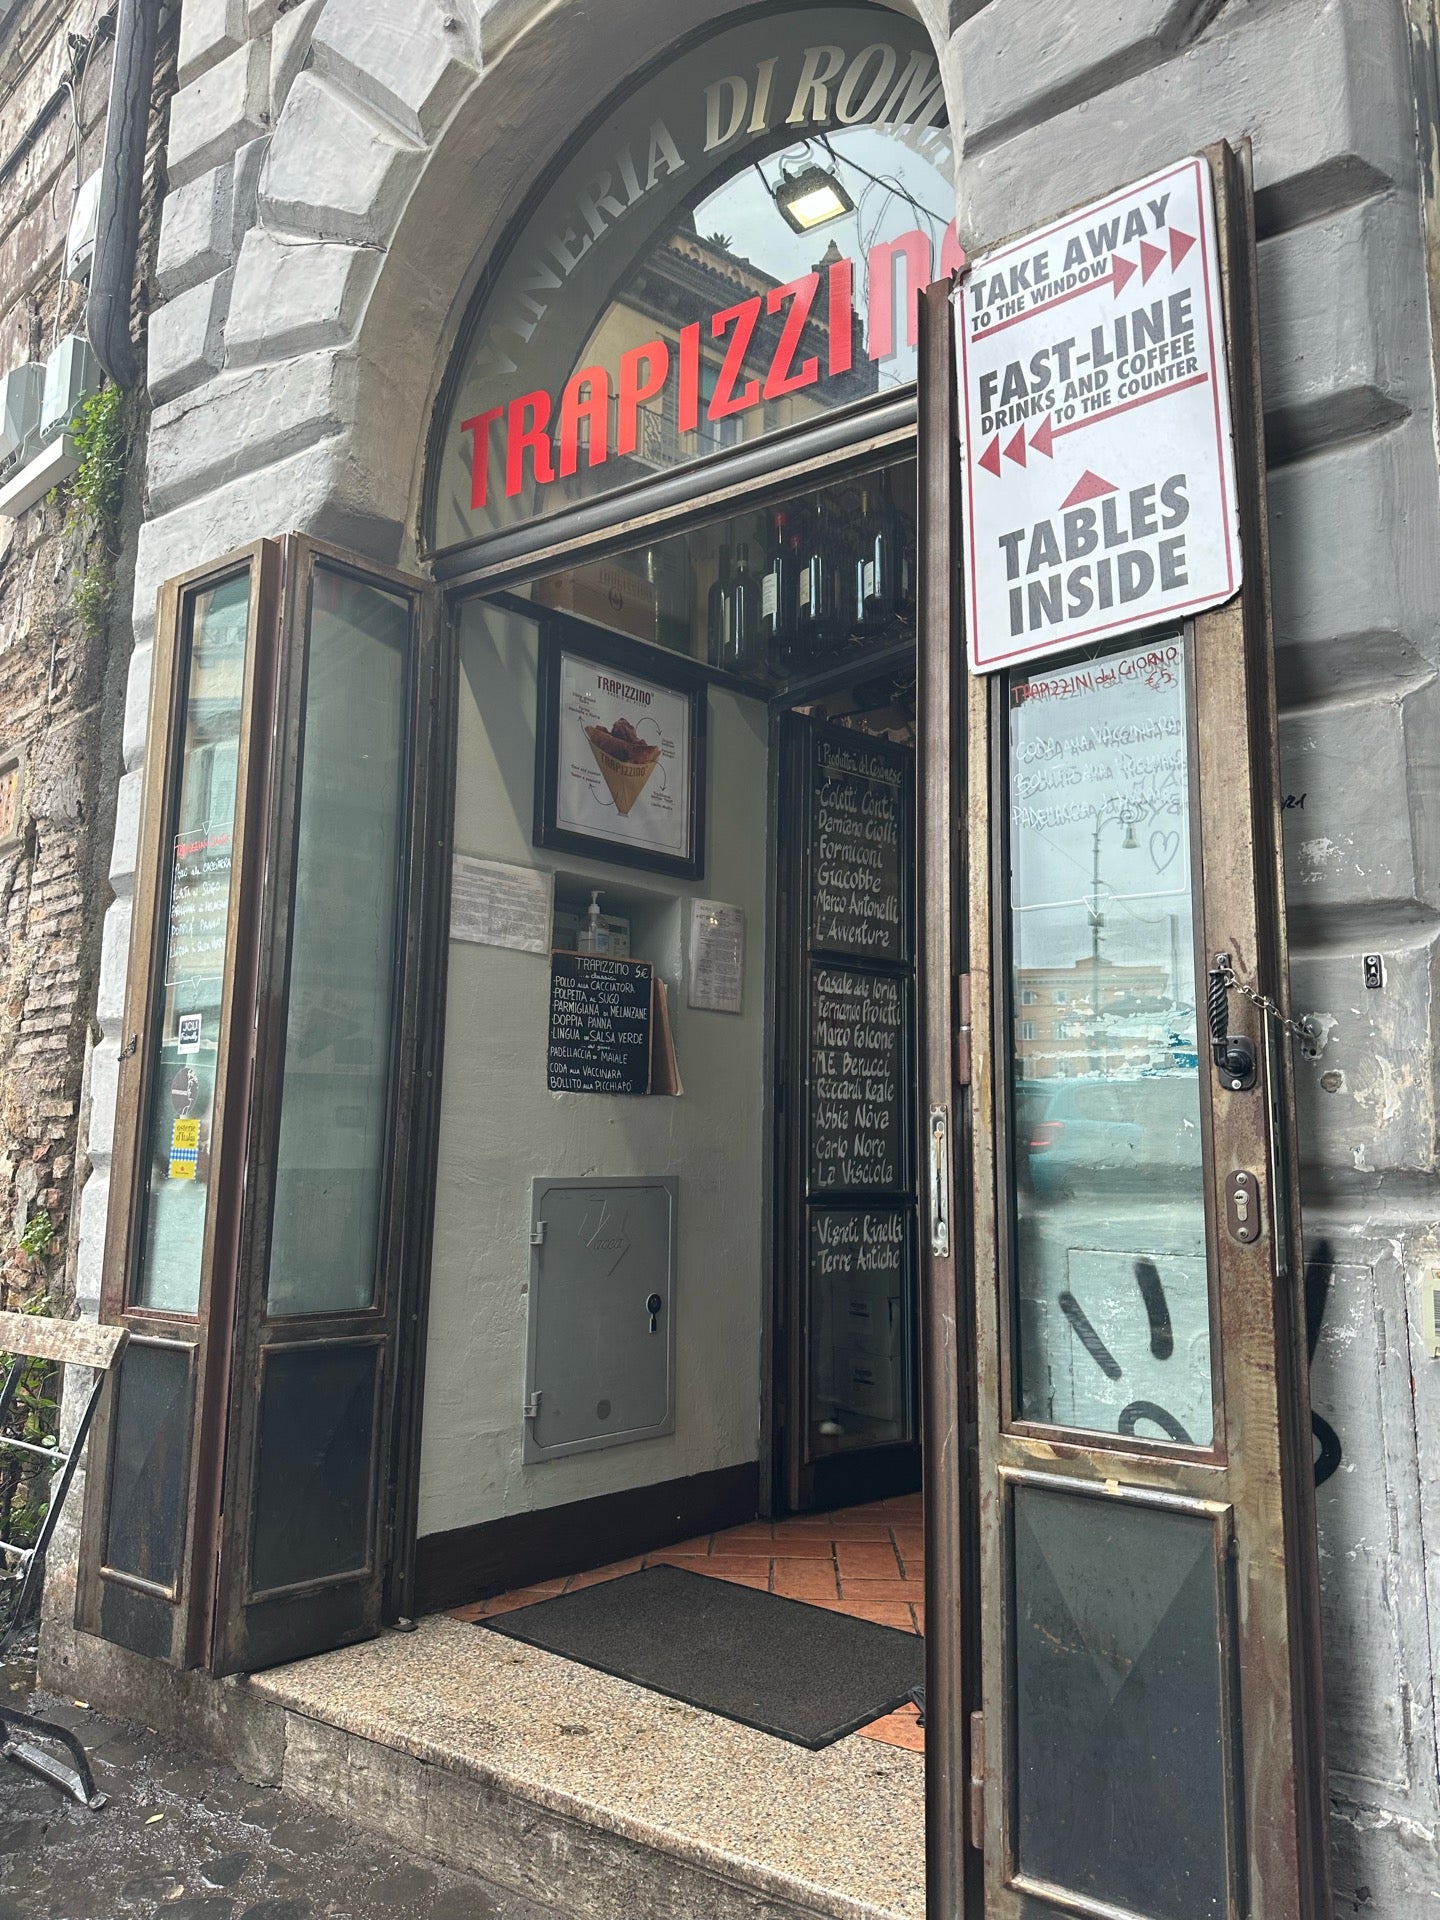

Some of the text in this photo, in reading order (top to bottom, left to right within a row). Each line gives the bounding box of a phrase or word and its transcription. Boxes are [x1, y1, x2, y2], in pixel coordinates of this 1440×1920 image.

[475, 117, 686, 382] VINERIA
[701, 56, 779, 156] DI
[970, 192, 1171, 314] TAKE AWAY
[971, 259, 1107, 331] TO THE WINDOW
[978, 288, 1193, 415] FAST-LINE
[981, 332, 1196, 435] DRINKS AND COFFEE
[1054, 357, 1199, 425] TO THE COUNTER
[999, 473, 1190, 580] TABLES
[1009, 534, 1190, 637] INSIDE
[1011, 672, 1093, 704] TRAPIZZINI
[1118, 646, 1178, 676] GIORNO
[862, 791, 895, 820] Conti
[865, 821, 898, 845] Ciolli
[819, 835, 883, 868] Formiconi
[817, 862, 881, 893] Giacobbe
[816, 889, 899, 924] Marco Antonelli
[554, 988, 588, 1003] POLPETTA
[598, 992, 619, 1005] SUGO
[555, 975, 576, 988] POLLO
[590, 980, 635, 994] CACCIATORA
[817, 970, 852, 995] Casale
[553, 1000, 600, 1017] PARMIGIANA
[610, 1006, 648, 1020] MELANZANE
[553, 1013, 612, 1030] DOPPIA PANNA
[552, 1027, 581, 1040] LINGUA
[589, 1029, 616, 1044] SALSA
[617, 1031, 644, 1045] VERDE
[817, 1022, 894, 1050] Marco Falcone
[550, 1046, 592, 1061] PADELLACCIA
[600, 1051, 629, 1065] MAIALE
[842, 1051, 890, 1077] Berucci
[549, 1062, 568, 1074] CODA
[582, 1064, 622, 1080] VACCINARA
[549, 1076, 582, 1089] BOLLITO
[817, 1077, 894, 1103] Riccardi Reale
[816, 1106, 890, 1130] Abbia Nova
[816, 1136, 886, 1160] Carlo Noro
[817, 1160, 894, 1187] La Visciola
[817, 1216, 859, 1247] Vigneti
[817, 1244, 900, 1275] Terre Antiche
